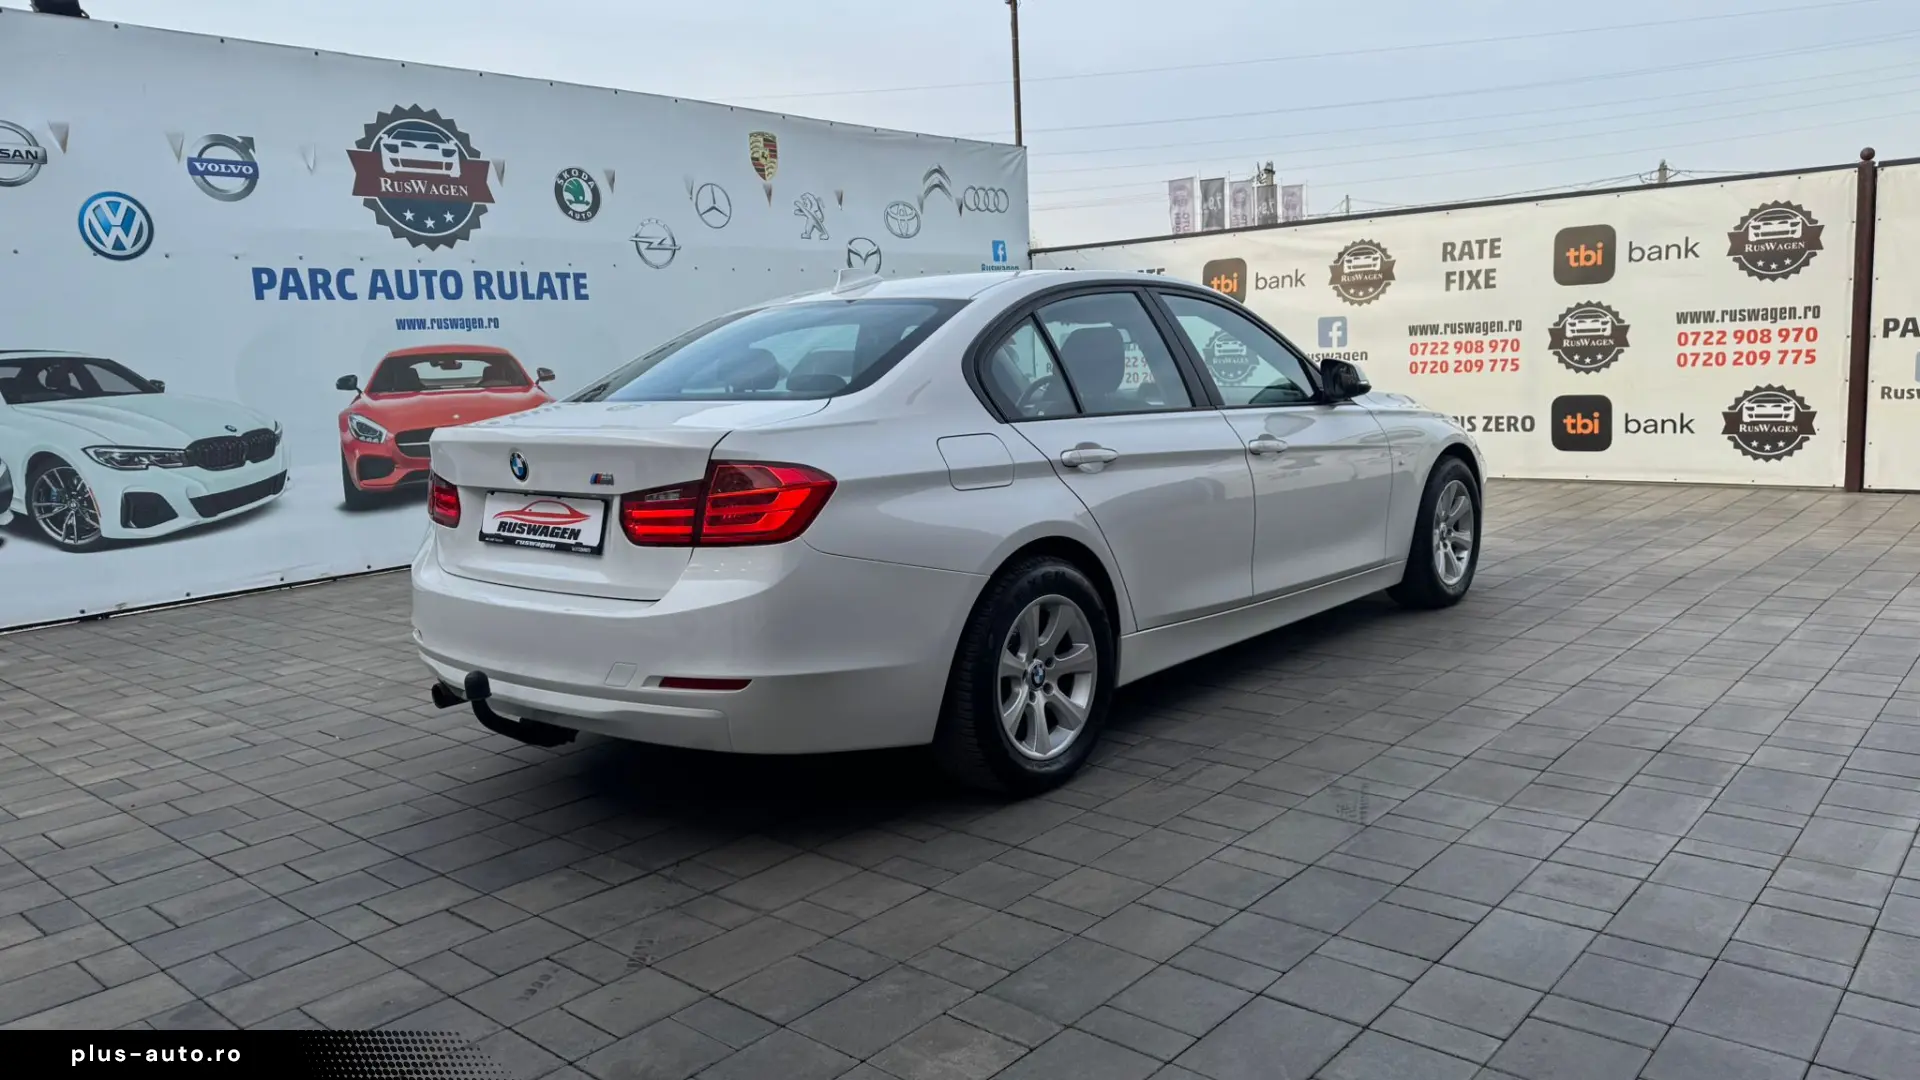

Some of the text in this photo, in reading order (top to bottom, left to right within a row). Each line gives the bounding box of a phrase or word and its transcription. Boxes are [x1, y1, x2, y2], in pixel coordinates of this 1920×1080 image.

[193, 161, 254, 175] VOLVO
[568, 210, 592, 220] AUTO
[1441, 237, 1502, 262] RATE
[1566, 236, 1700, 269] tbi bank
[251, 267, 590, 301] PARC AUTO RULATE
[1211, 268, 1306, 293] tbi bank
[1445, 267, 1497, 291] FIXE
[395, 316, 500, 332] www.ruswagen.ro
[1675, 304, 1821, 325] www.ruswagen.ro
[1408, 319, 1522, 337] www.ruswagen.ro
[1676, 326, 1819, 348] 0722 908 970
[1409, 338, 1521, 356] 0722 908 970
[1409, 357, 1520, 375] 0720 209 775
[1676, 348, 1817, 368] 0720 209 775
[1482, 415, 1535, 432] ZERO
[1563, 411, 1695, 435] tbi bank
[496, 520, 581, 541] RUSWAGEN
